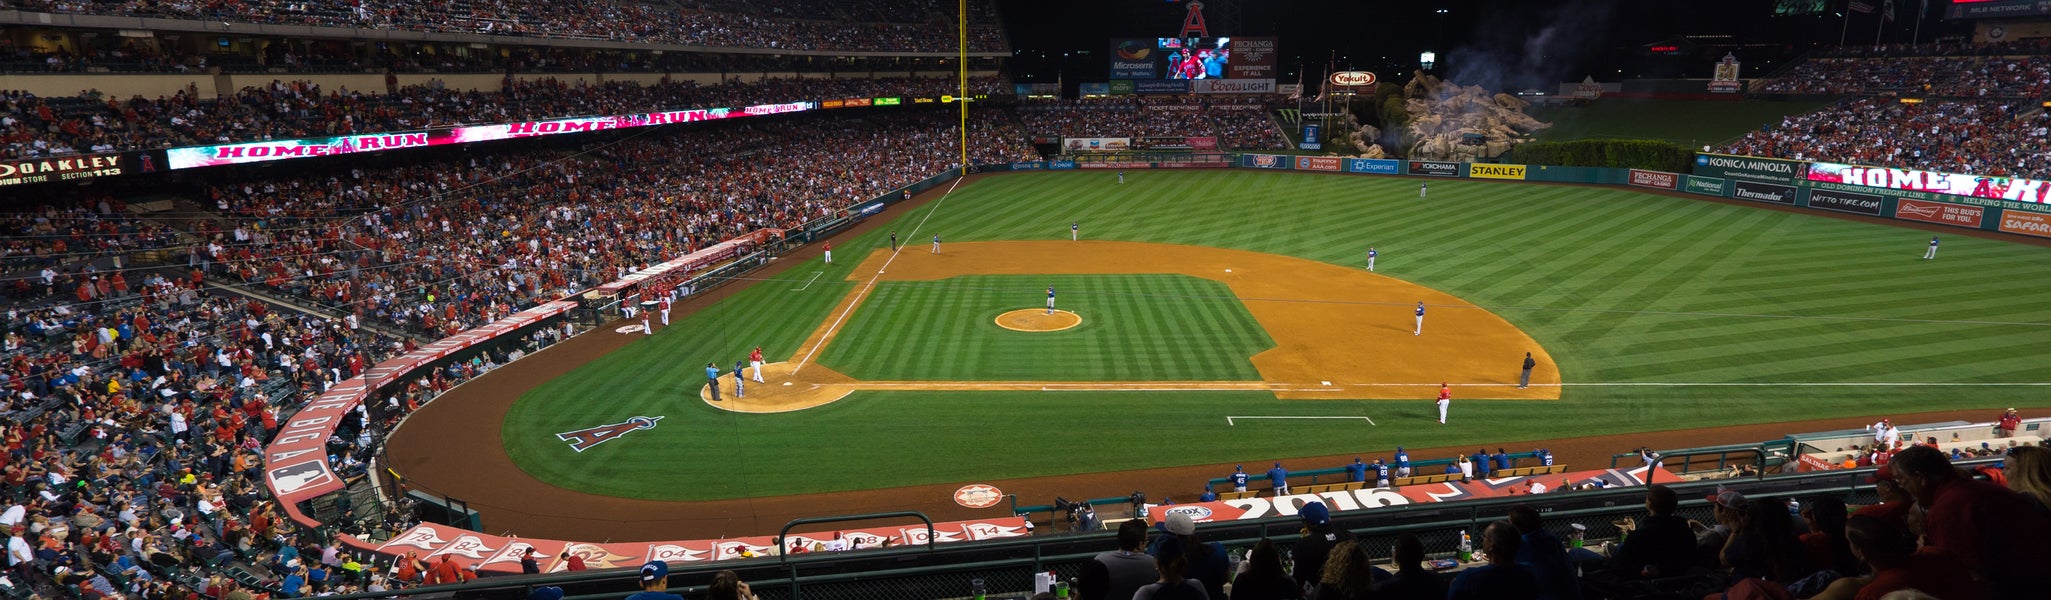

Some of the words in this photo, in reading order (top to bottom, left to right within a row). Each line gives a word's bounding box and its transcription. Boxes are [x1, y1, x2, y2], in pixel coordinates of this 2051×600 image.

[1989, 4, 2031, 12] NETWORK
[1179, 2, 1209, 38] A
[1233, 40, 1273, 48] PECHANGA
[1114, 61, 1154, 70] Microsemi
[1210, 80, 1242, 91] Coors
[1242, 82, 1270, 91] LIGHT
[745, 106, 771, 114] HOME
[507, 120, 617, 134] HOME
[649, 109, 706, 125] RUN
[216, 144, 330, 159] HOME
[358, 132, 428, 149] RUN
[19, 155, 118, 174] OAKLEY
[1366, 162, 1394, 171] Experian
[1471, 166, 1525, 176] STANLEY
[1709, 157, 1746, 170] KONICA
[1746, 161, 1792, 173] MINOLTA
[22, 174, 48, 184] STORE
[61, 171, 93, 180] SECTION
[93, 168, 122, 177] 113
[1634, 171, 1672, 182] PECHANGA
[1842, 167, 1951, 191] HOME
[1695, 180, 1723, 189] National
[1820, 182, 1836, 190] OLD
[1836, 184, 1873, 194] DOMINION
[1873, 187, 1908, 198] FREIGHT
[1907, 190, 1927, 199] LINE
[1736, 187, 1784, 201] Thermador
[1811, 194, 1838, 205] NITTO
[1839, 197, 1880, 210] TIRE.COM
[1963, 196, 2001, 208] HELPING
[2001, 199, 2021, 209] THE
[1903, 205, 1937, 214] Budweiser
[1943, 206, 1959, 214] THIS
[1959, 208, 1982, 217] BUD'S
[1942, 213, 1956, 221] FOR
[1956, 215, 1973, 223] YOU.
[304, 383, 370, 412] THE
[275, 415, 333, 446] BIG
[270, 446, 320, 464] A
[1801, 455, 1829, 471] SALINAS
[1224, 487, 1410, 520] 2016
[975, 526, 1000, 536] '14
[658, 549, 686, 559] '04
